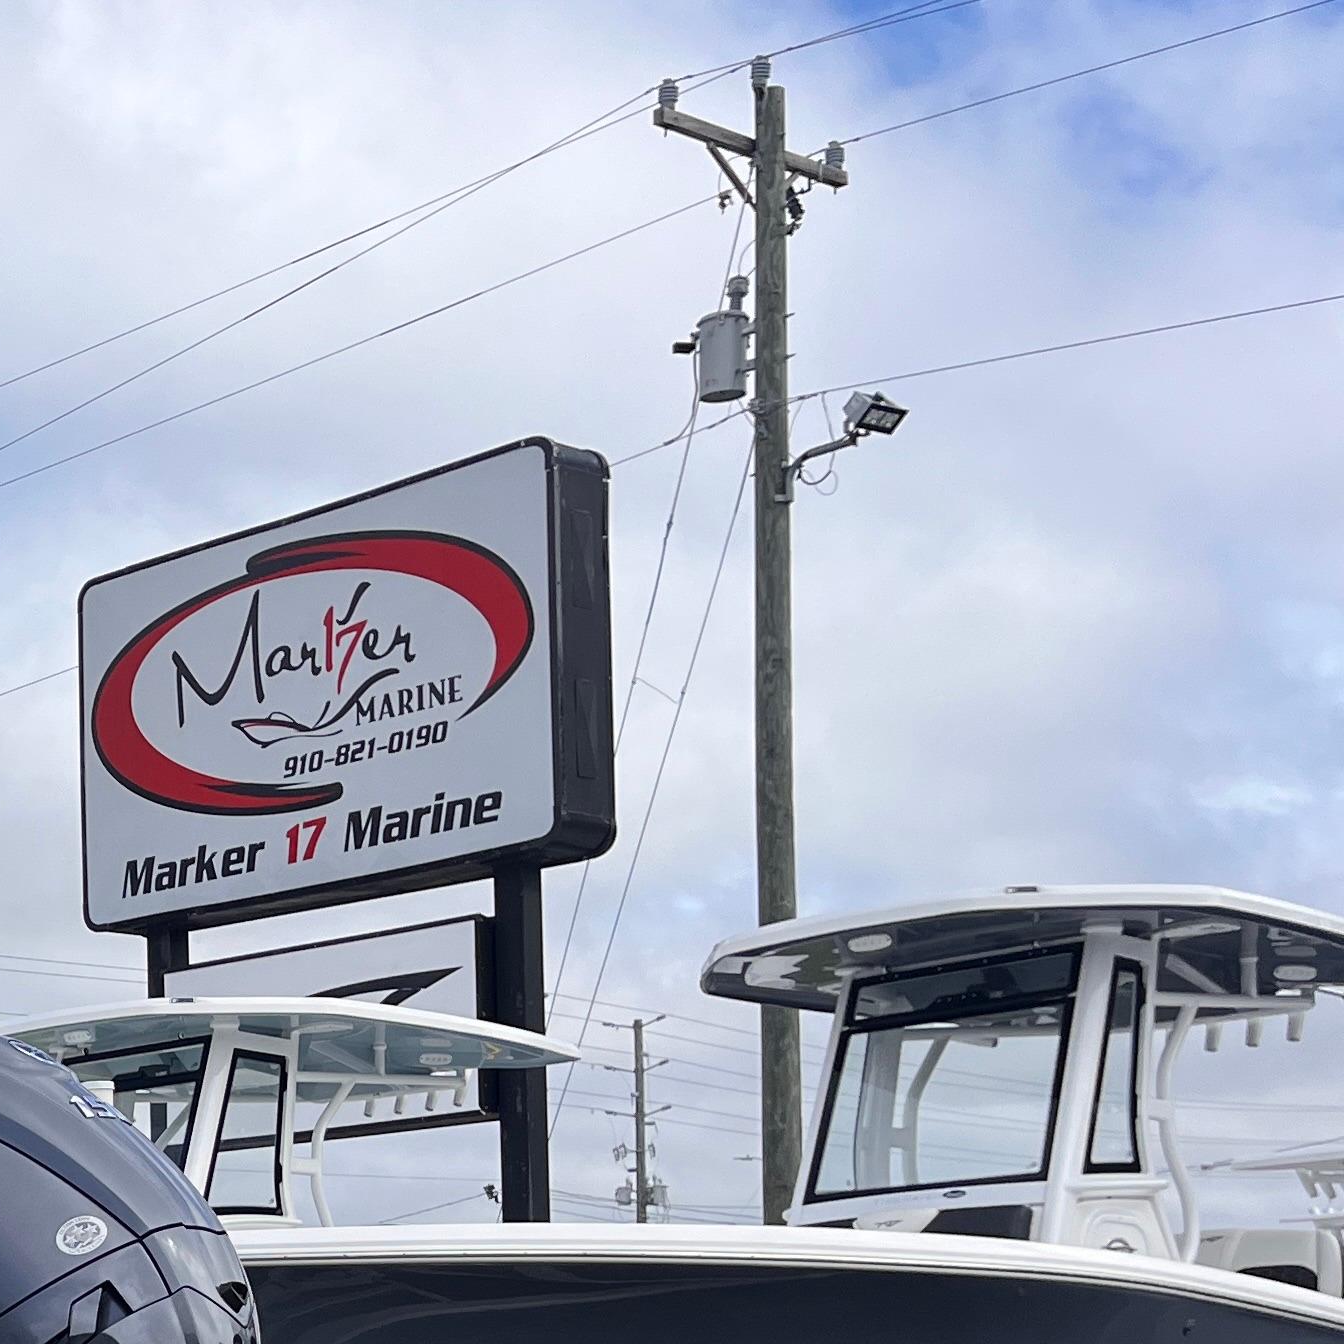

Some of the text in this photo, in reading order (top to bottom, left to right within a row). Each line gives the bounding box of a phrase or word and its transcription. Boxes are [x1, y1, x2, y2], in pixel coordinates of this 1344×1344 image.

[355, 675, 463, 727] MARINE
[283, 720, 449, 779] 910-821-0190
[122, 789, 503, 899] Marker 17 Marine
